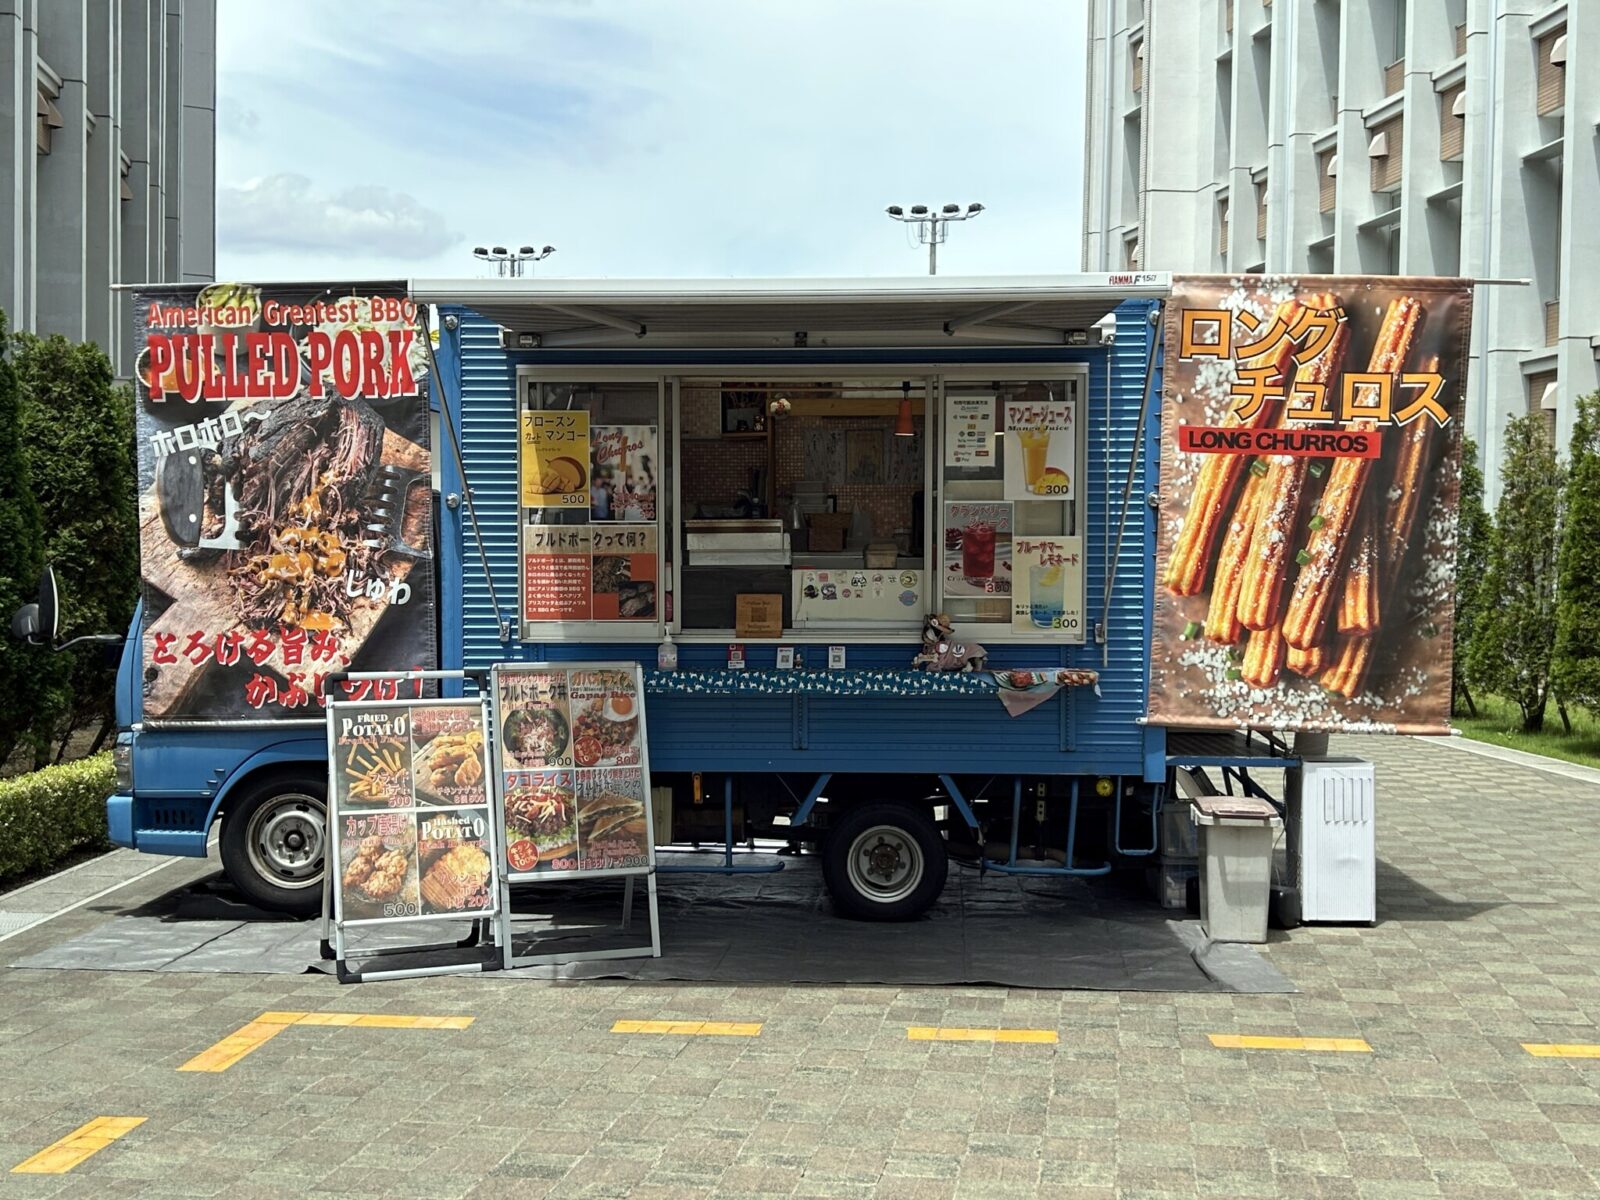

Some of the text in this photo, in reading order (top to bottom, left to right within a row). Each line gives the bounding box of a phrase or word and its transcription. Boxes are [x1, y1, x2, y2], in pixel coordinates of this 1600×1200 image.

[1109, 275, 1132, 285] FIAMMA
[148, 295, 418, 328] American Greatest BBQ
[1179, 305, 1349, 368] ロング
[147, 329, 419, 403] PULLED PORK
[1230, 364, 1452, 428] チュロス
[1009, 404, 1073, 424] マンゴージュース
[1189, 431, 1369, 454] LONG CHURROS
[1045, 485, 1069, 494] 300
[562, 495, 585, 504] 500
[951, 504, 1008, 518] クランベリー
[1040, 553, 1079, 567] レモネード
[347, 569, 412, 605] じゅわ
[986, 583, 1010, 593] 300
[1053, 617, 1078, 629] 300
[570, 690, 636, 701] Gapao Rice
[357, 712, 389, 723] FRIED
[550, 756, 572, 767] 900
[616, 755, 639, 766] 800
[507, 772, 574, 789] タコライス
[388, 795, 412, 808] 500
[625, 855, 648, 867] 900
[383, 902, 417, 917] 500
